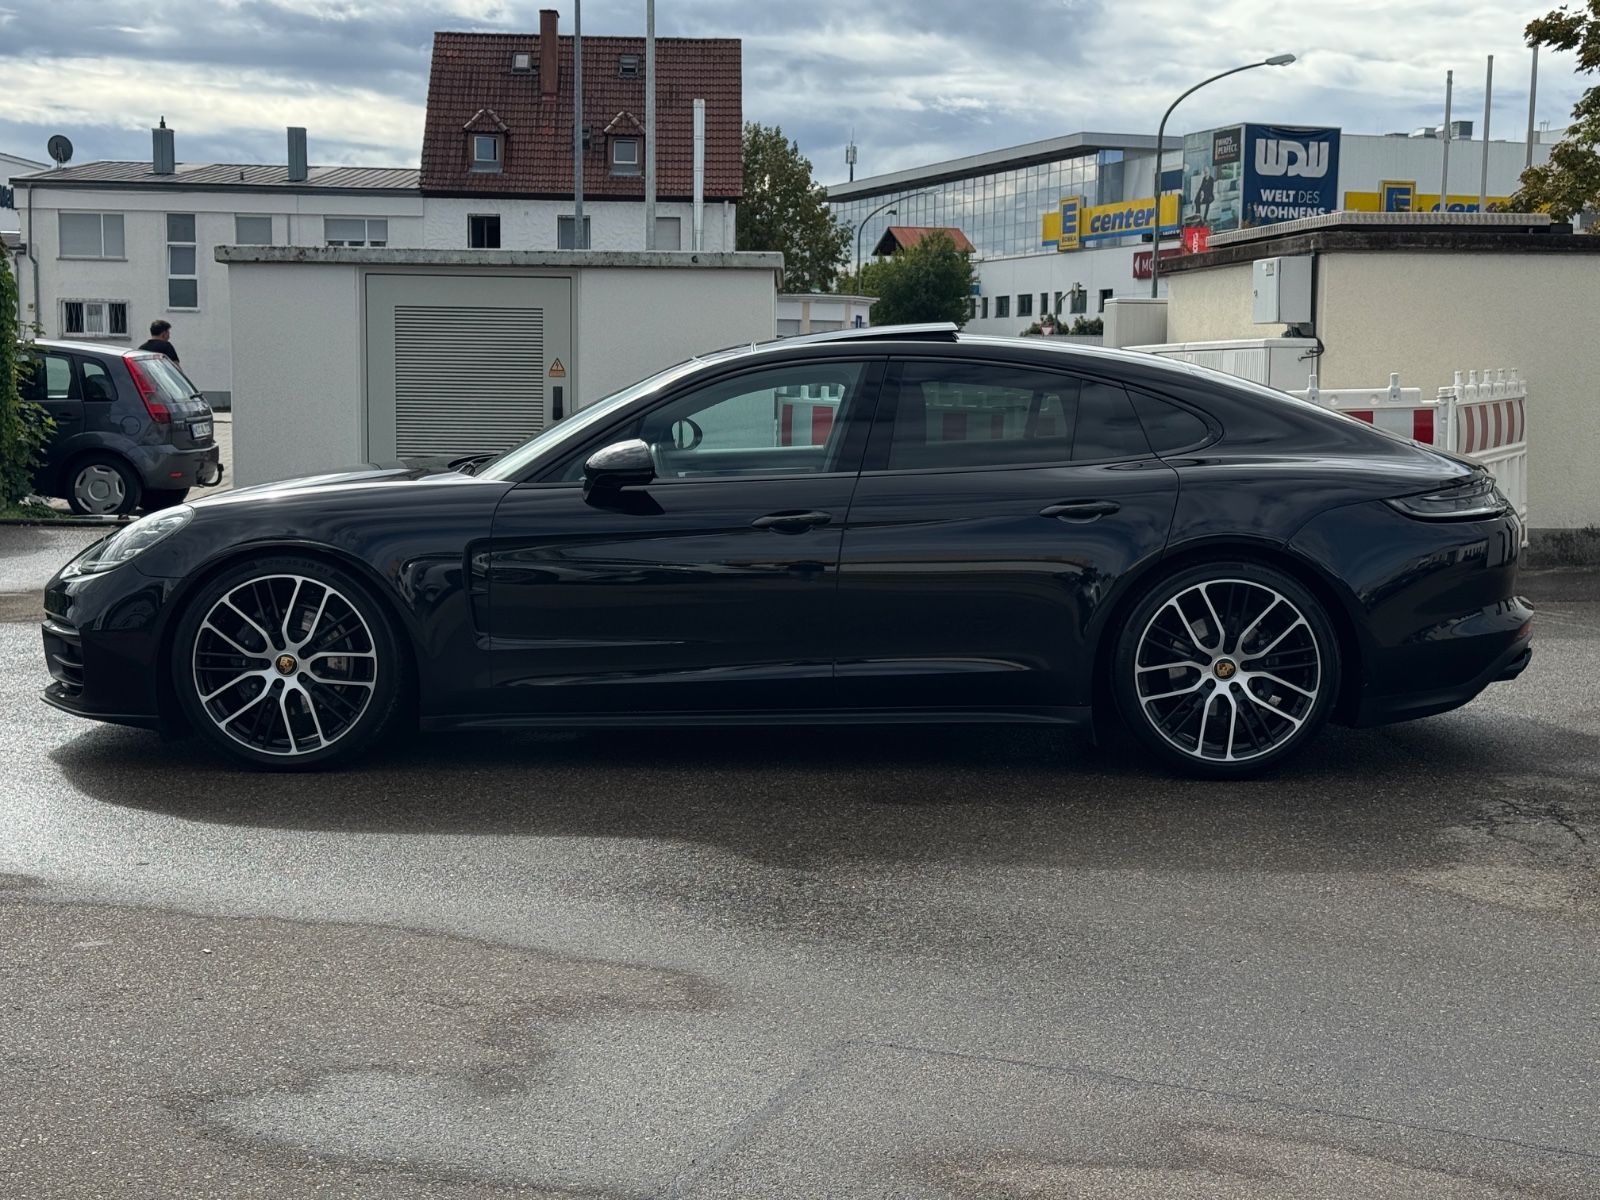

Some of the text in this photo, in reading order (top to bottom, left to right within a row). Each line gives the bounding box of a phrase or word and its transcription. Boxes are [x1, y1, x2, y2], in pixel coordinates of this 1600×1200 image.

[1260, 189, 1321, 204] WELT DES
[1062, 203, 1155, 235] E center
[1253, 205, 1327, 219] WOHNENS
